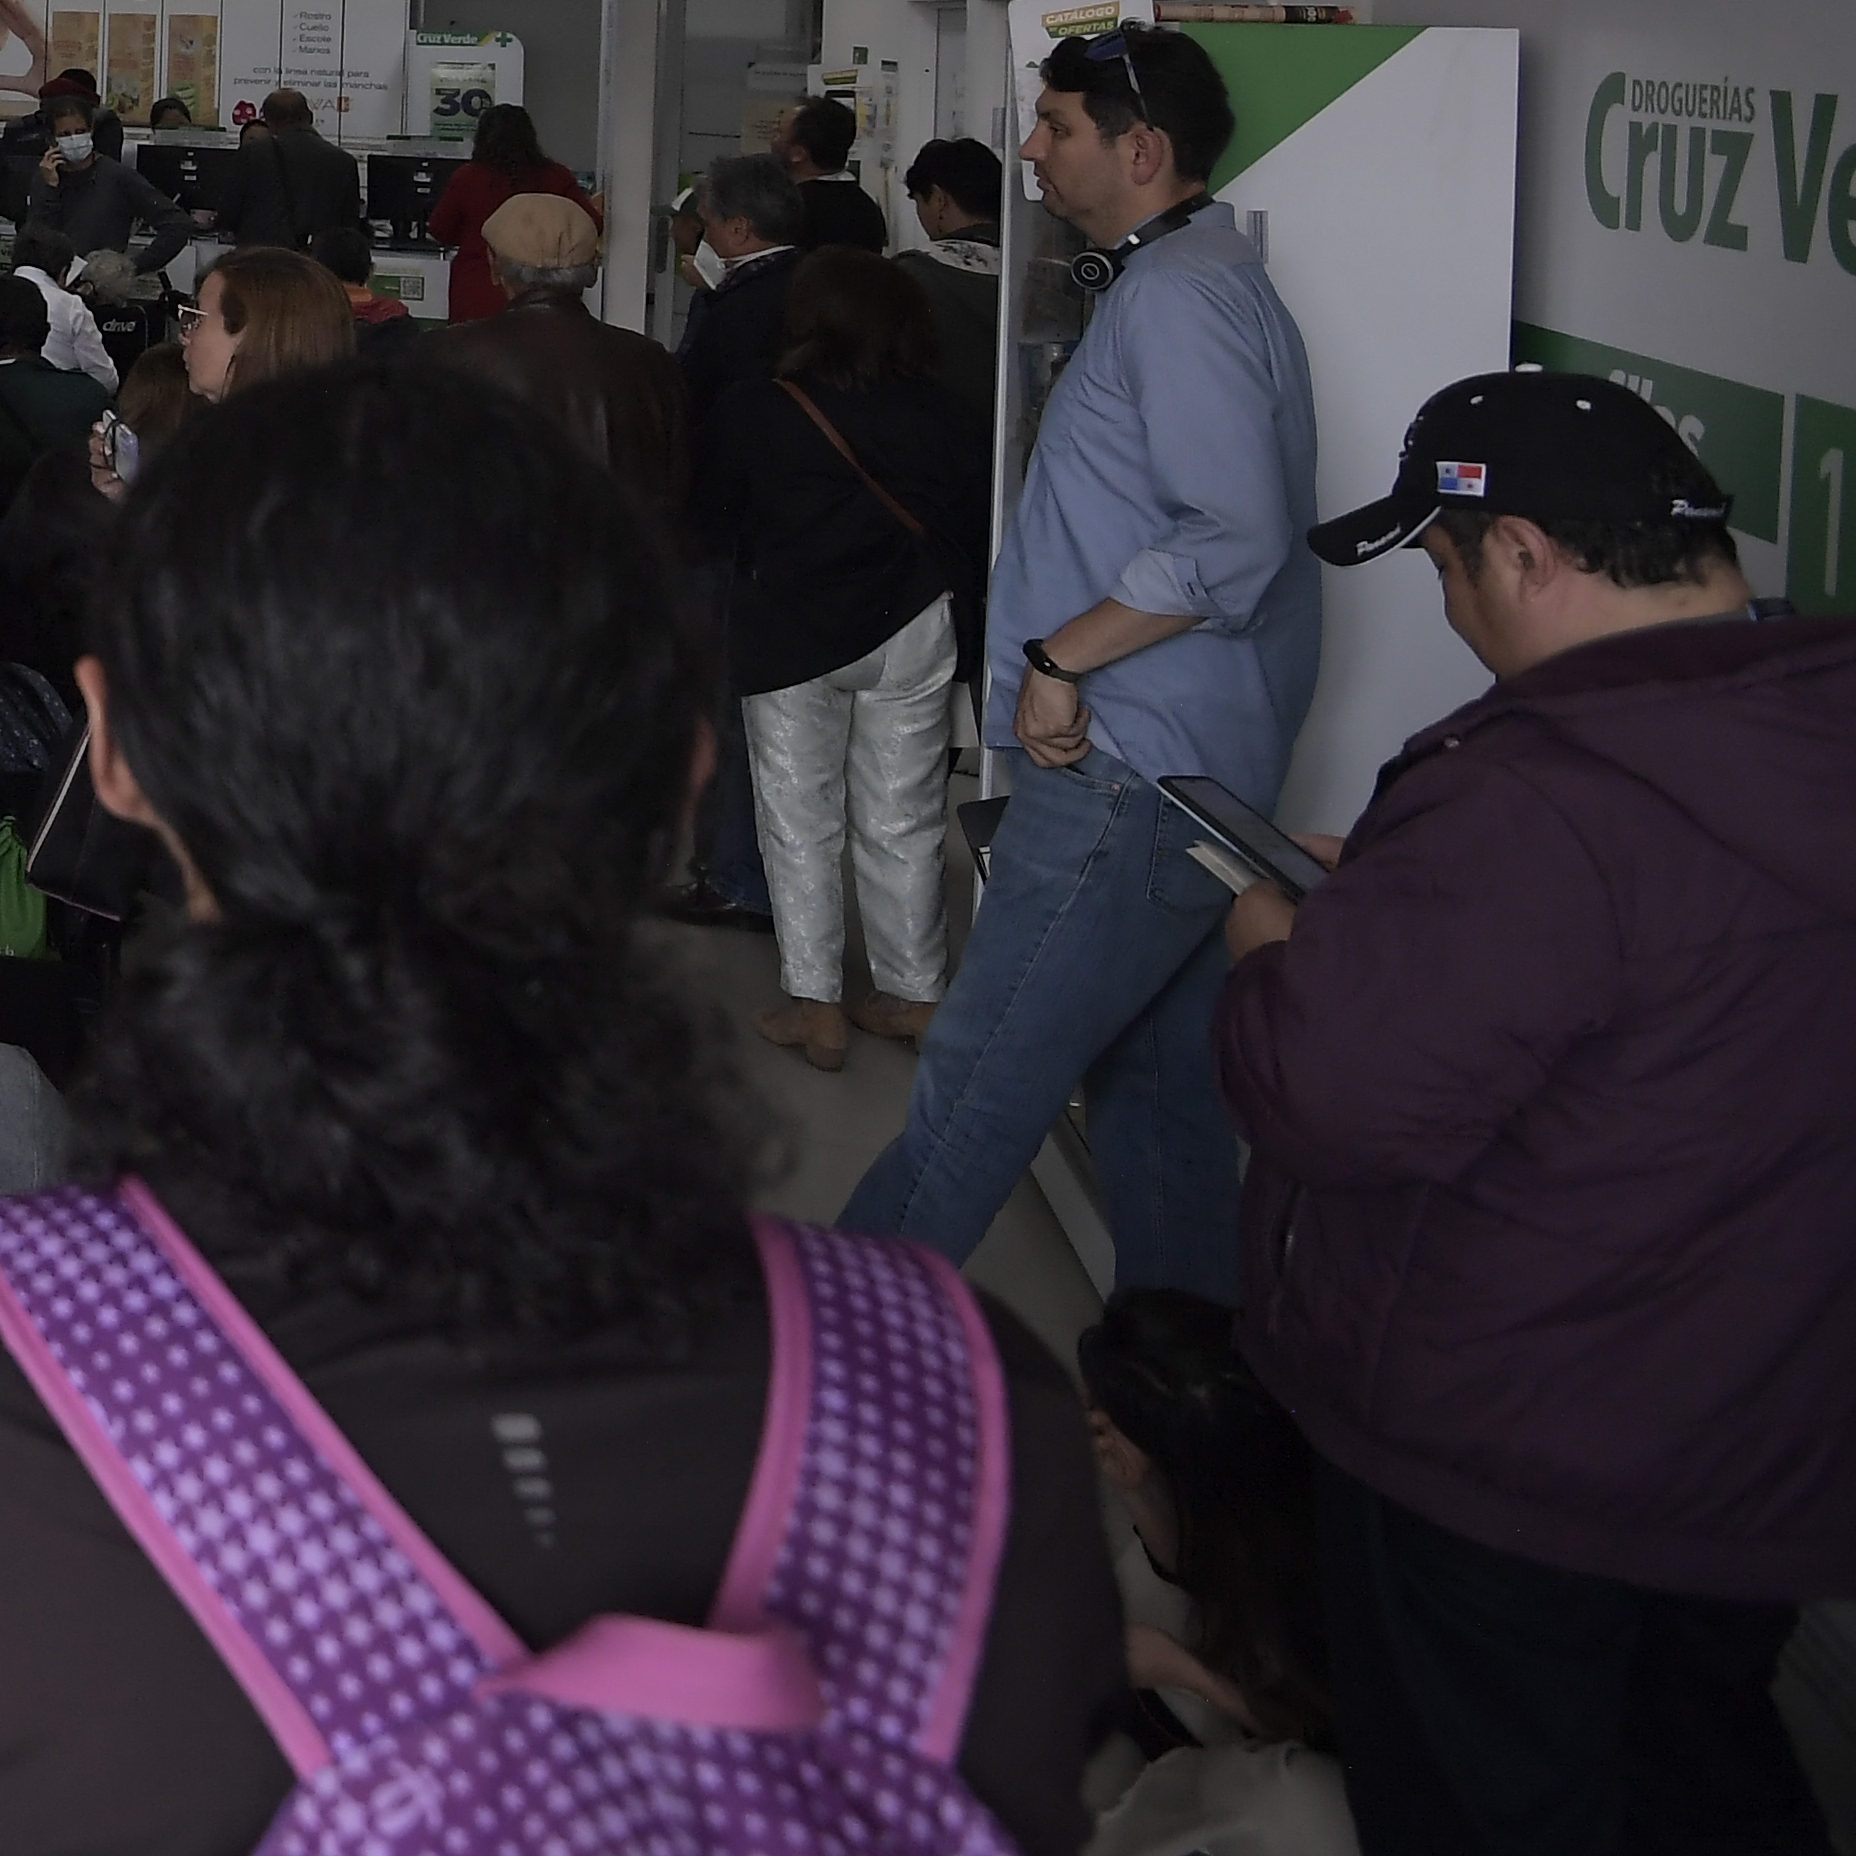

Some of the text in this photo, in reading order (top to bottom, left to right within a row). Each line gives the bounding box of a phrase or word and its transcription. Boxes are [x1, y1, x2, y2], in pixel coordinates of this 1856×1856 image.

[299, 11, 331, 20] Rostro
[299, 22, 329, 31] Cuello
[1058, 21, 1115, 36] OFERTAS
[299, 34, 331, 43] Escote
[417, 32, 479, 44] Cruz Verde
[253, 67, 271, 75] con
[347, 70, 370, 79] para
[234, 77, 271, 87] prevenir
[283, 79, 321, 88] eliminar
[324, 80, 338, 88] las
[341, 81, 387, 91] manchas
[1631, 75, 1755, 124] DROGUERÍAS
[1584, 71, 1755, 252] Cruz
[102, 318, 136, 332] drive
